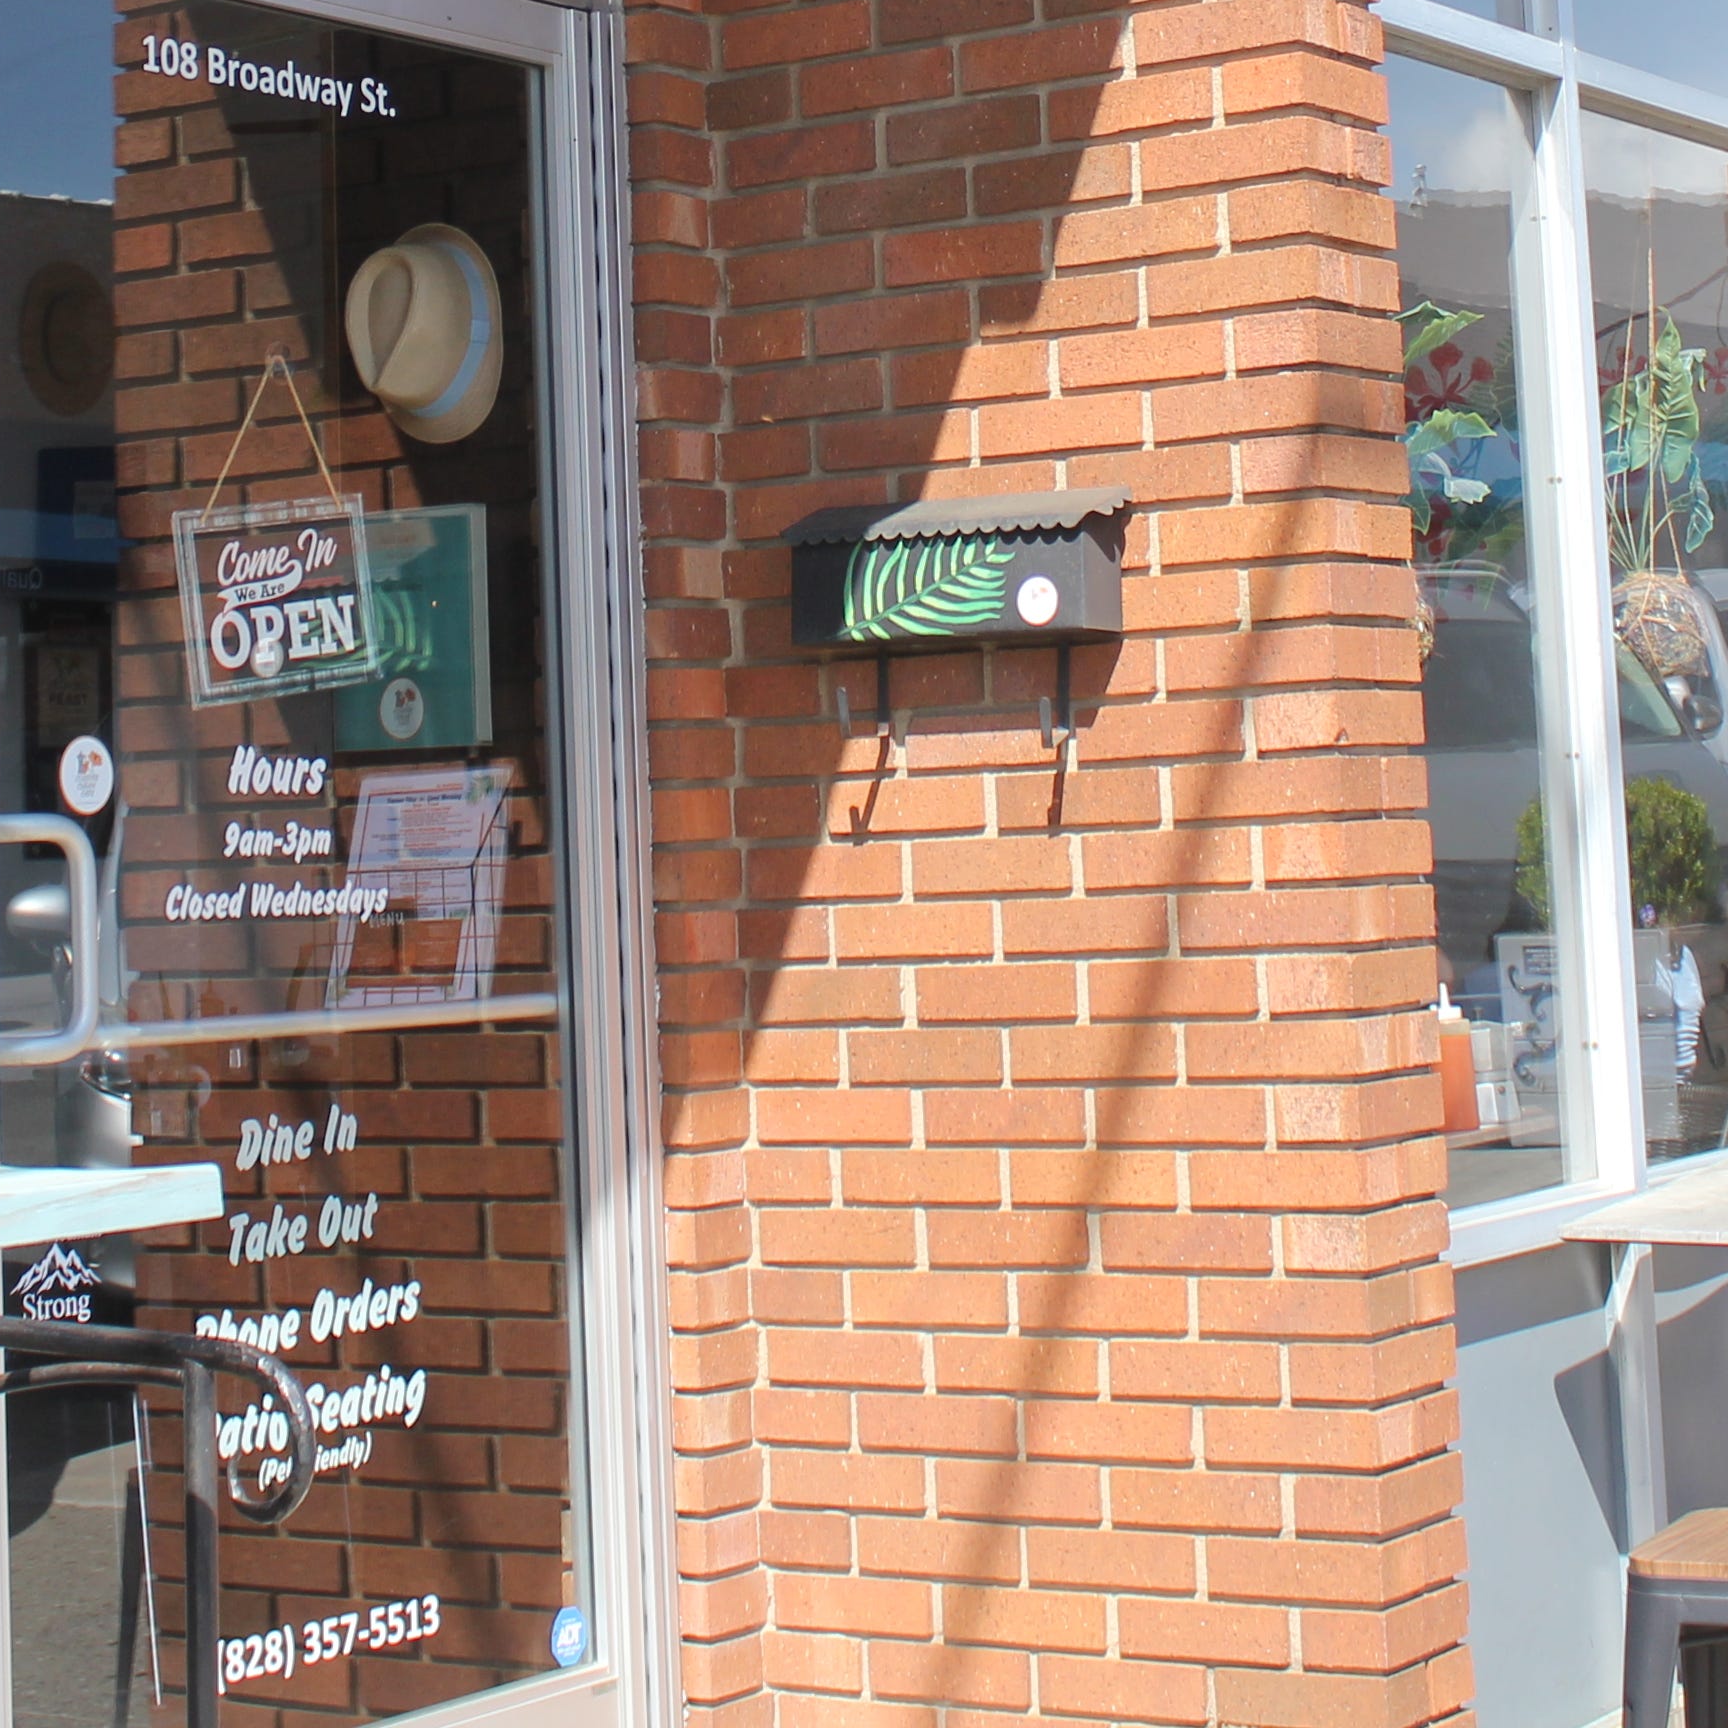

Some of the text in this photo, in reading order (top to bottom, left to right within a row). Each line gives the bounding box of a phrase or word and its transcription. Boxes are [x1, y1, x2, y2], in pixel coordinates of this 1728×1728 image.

[142, 34, 396, 118] 108 Broadway St.
[218, 528, 337, 586] Come In
[234, 580, 285, 602] We Are
[210, 594, 355, 670] OPEN
[228, 745, 327, 796] Hours
[223, 820, 332, 866] 9am-3pm
[165, 881, 244, 922] Closed
[250, 878, 388, 924] Wednesdays
[236, 1103, 358, 1172] Dine In
[228, 1193, 378, 1266] Take Out
[23, 1292, 91, 1323] Strong
[310, 1277, 421, 1343] Orders
[216, 1364, 426, 1459] atio Seating
[314, 1430, 372, 1473] iendly)
[216, 1595, 441, 1693] (828) 357-5513
